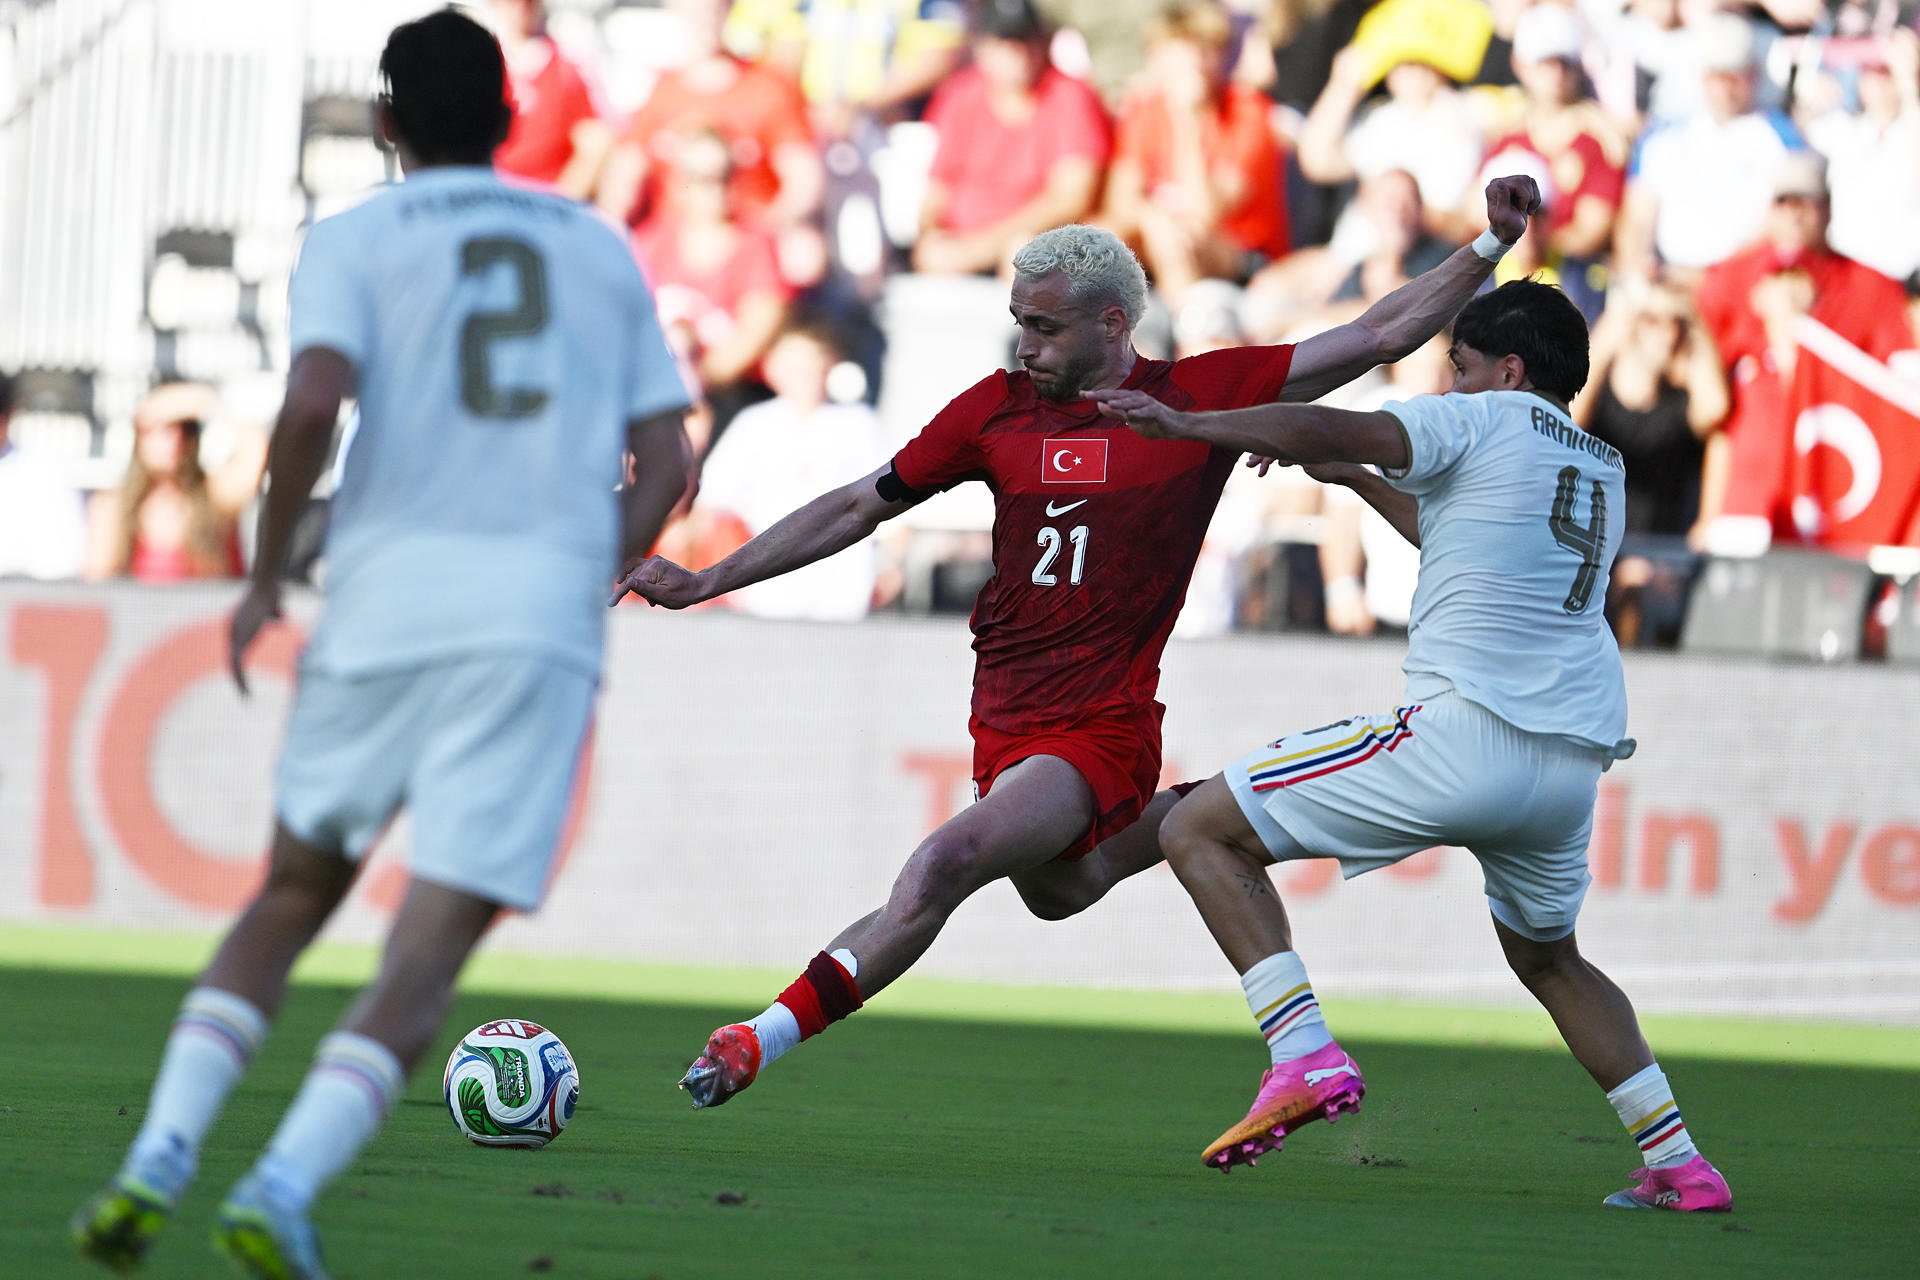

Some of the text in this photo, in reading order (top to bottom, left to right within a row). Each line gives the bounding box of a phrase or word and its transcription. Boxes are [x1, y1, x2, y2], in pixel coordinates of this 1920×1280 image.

[460, 236, 551, 418] 2
[1032, 525, 1089, 586] 21
[1549, 465, 1607, 615] 4
[514, 1055, 526, 1098] TRIONDA
